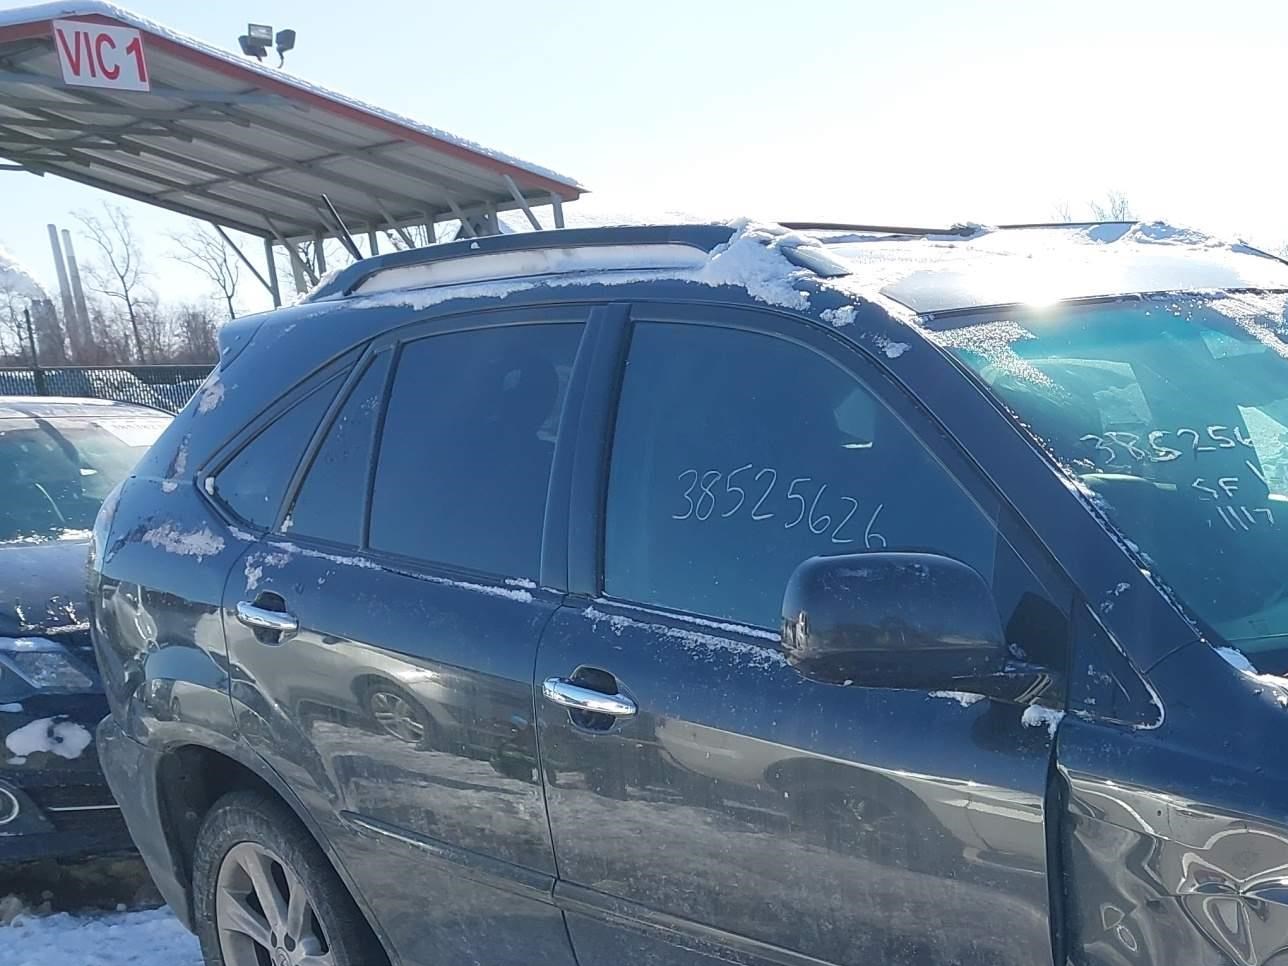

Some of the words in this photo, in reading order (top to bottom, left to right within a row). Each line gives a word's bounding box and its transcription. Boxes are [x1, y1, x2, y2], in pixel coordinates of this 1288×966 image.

[56, 28, 120, 80] VIC
[126, 37, 147, 82] 1
[671, 464, 887, 549] 38525626
